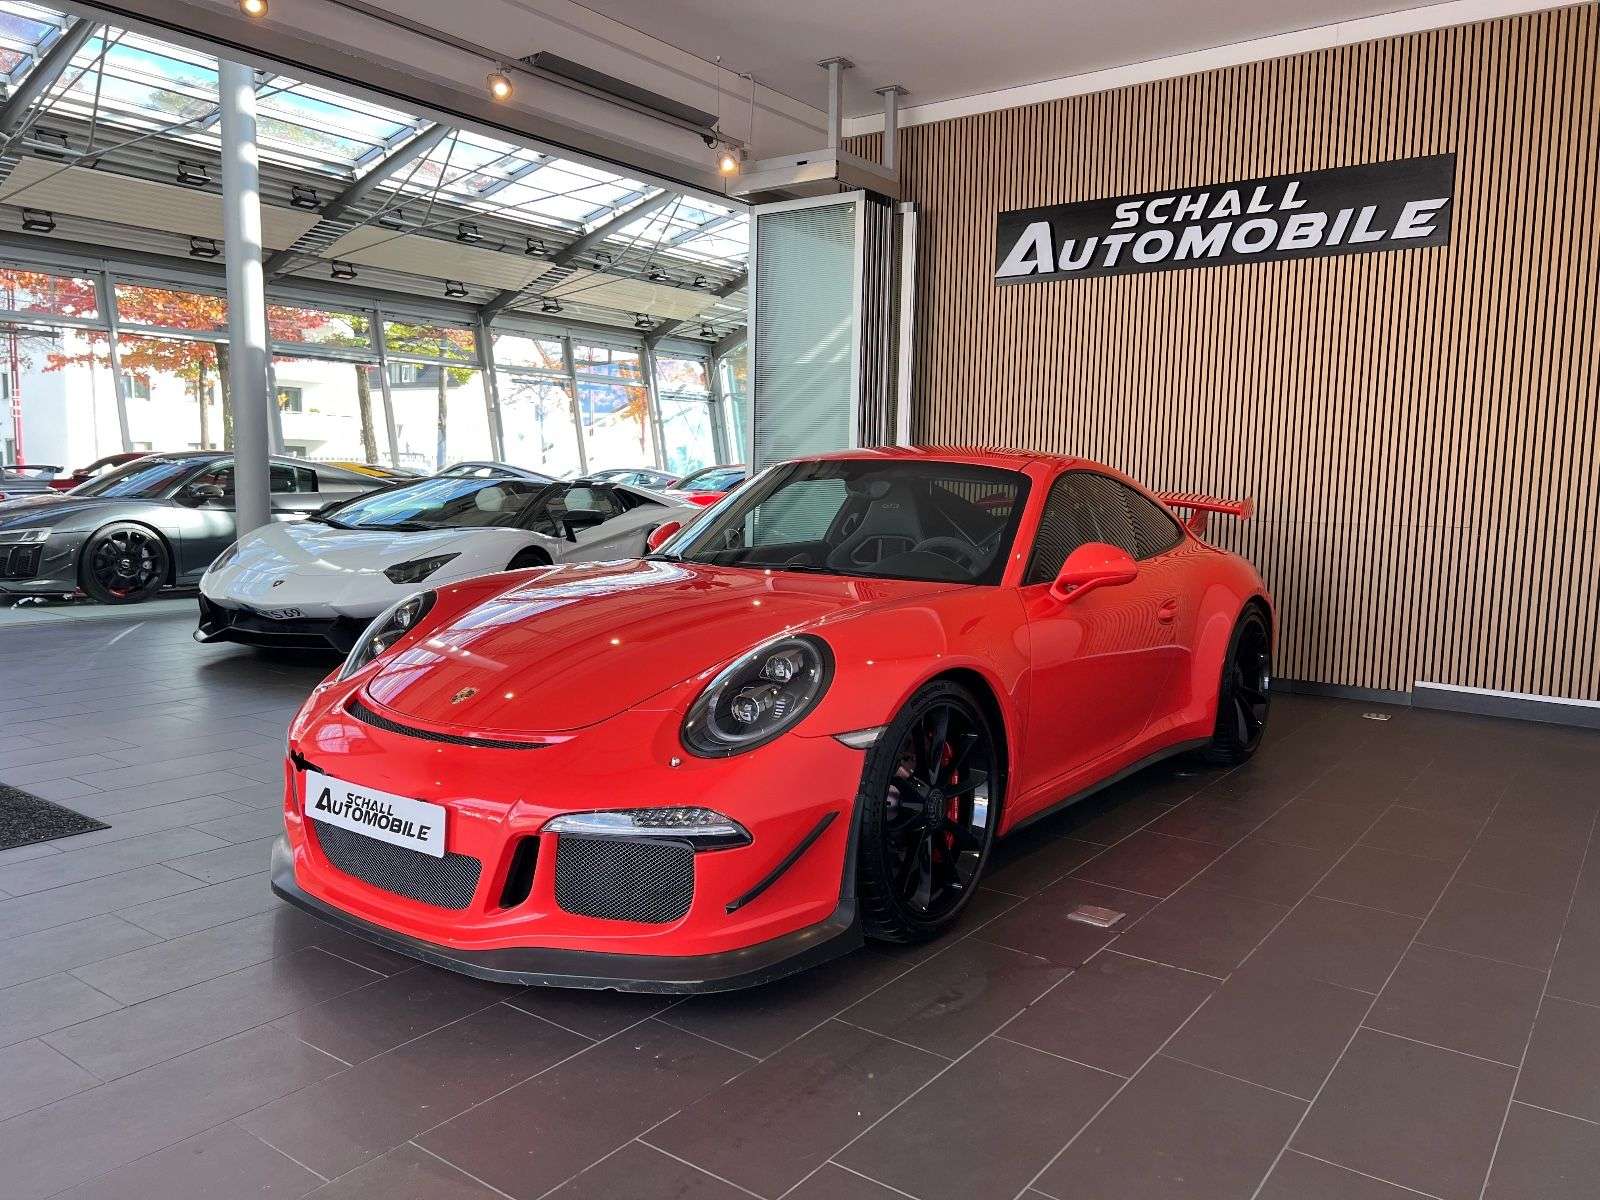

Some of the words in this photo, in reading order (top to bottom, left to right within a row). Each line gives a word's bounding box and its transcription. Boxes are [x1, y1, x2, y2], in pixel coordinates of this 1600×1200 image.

[1110, 181, 1308, 230] SCHALL
[994, 198, 1450, 278] AUTOMOBILE
[314, 787, 431, 842] AUTOMOBILE
[346, 793, 394, 816] SCHALL
